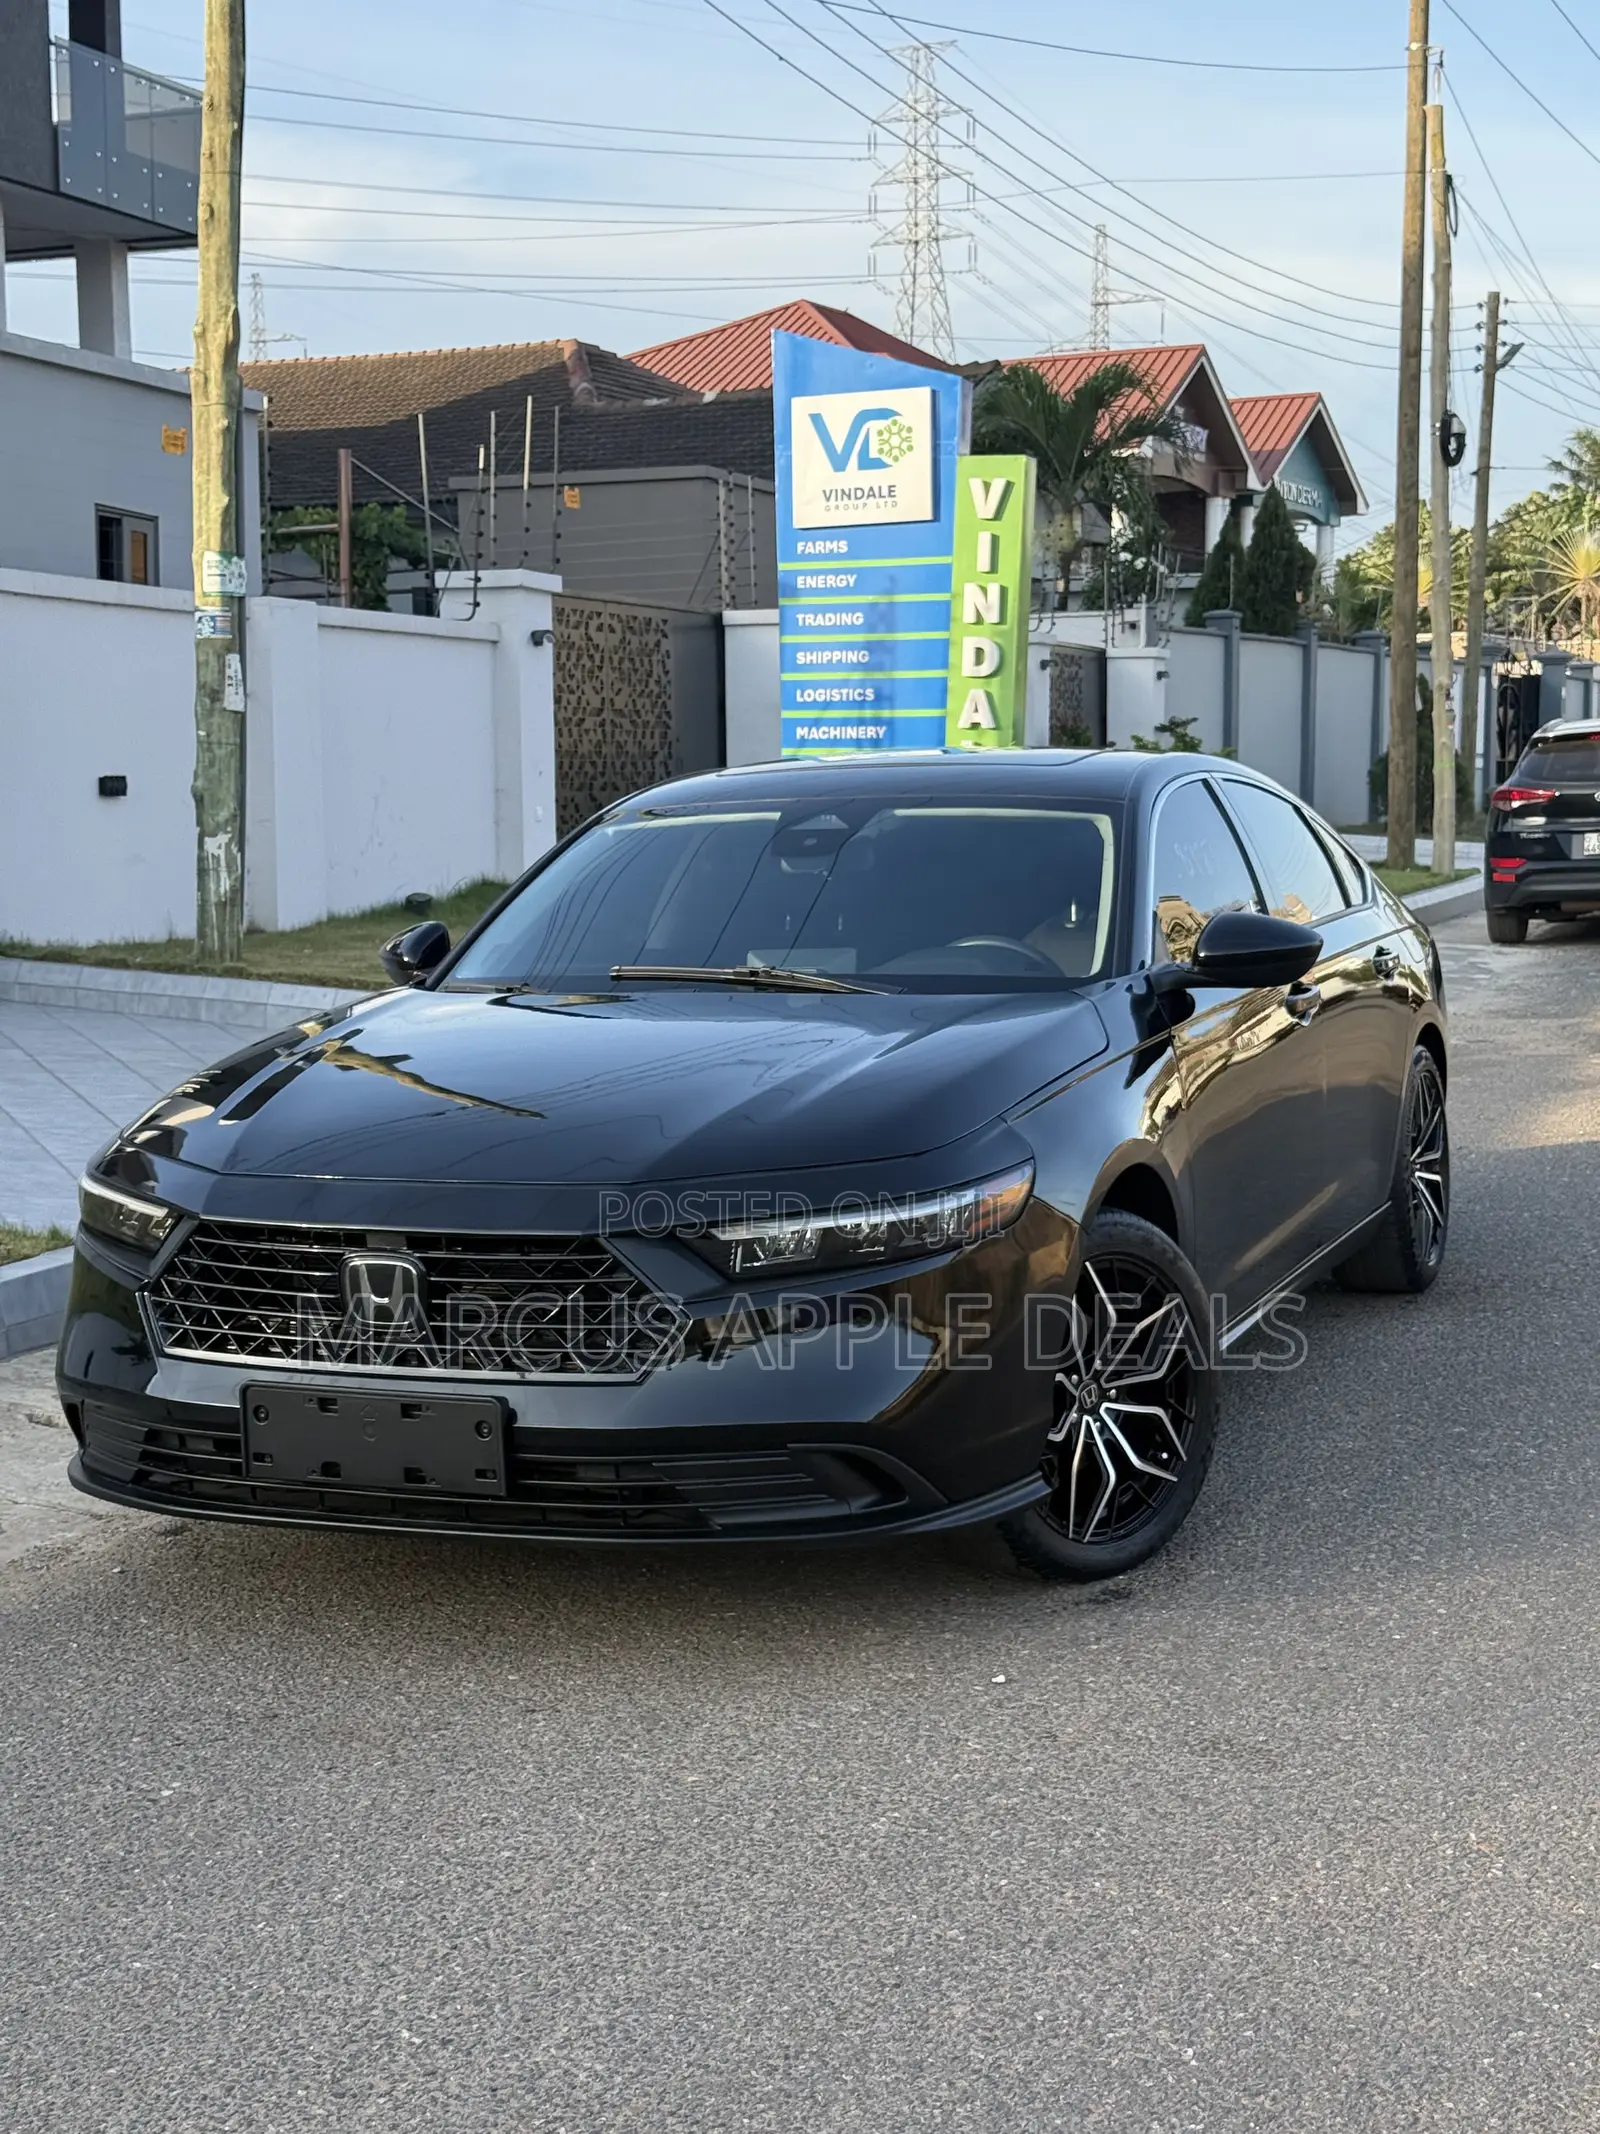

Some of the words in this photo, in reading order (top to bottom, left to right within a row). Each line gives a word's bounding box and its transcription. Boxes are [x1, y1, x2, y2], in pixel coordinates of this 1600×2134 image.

[822, 484, 897, 502] VINDALE
[824, 502, 868, 512] GROUP
[876, 500, 898, 509] LTD
[796, 540, 849, 554] FARMS
[796, 574, 858, 588] ENERGY
[796, 612, 864, 626] TRADING
[955, 477, 1007, 748] VINDA
[796, 650, 870, 665] SHIPPING
[796, 688, 875, 702] LOGISTICS
[796, 726, 887, 740] MACHINERY
